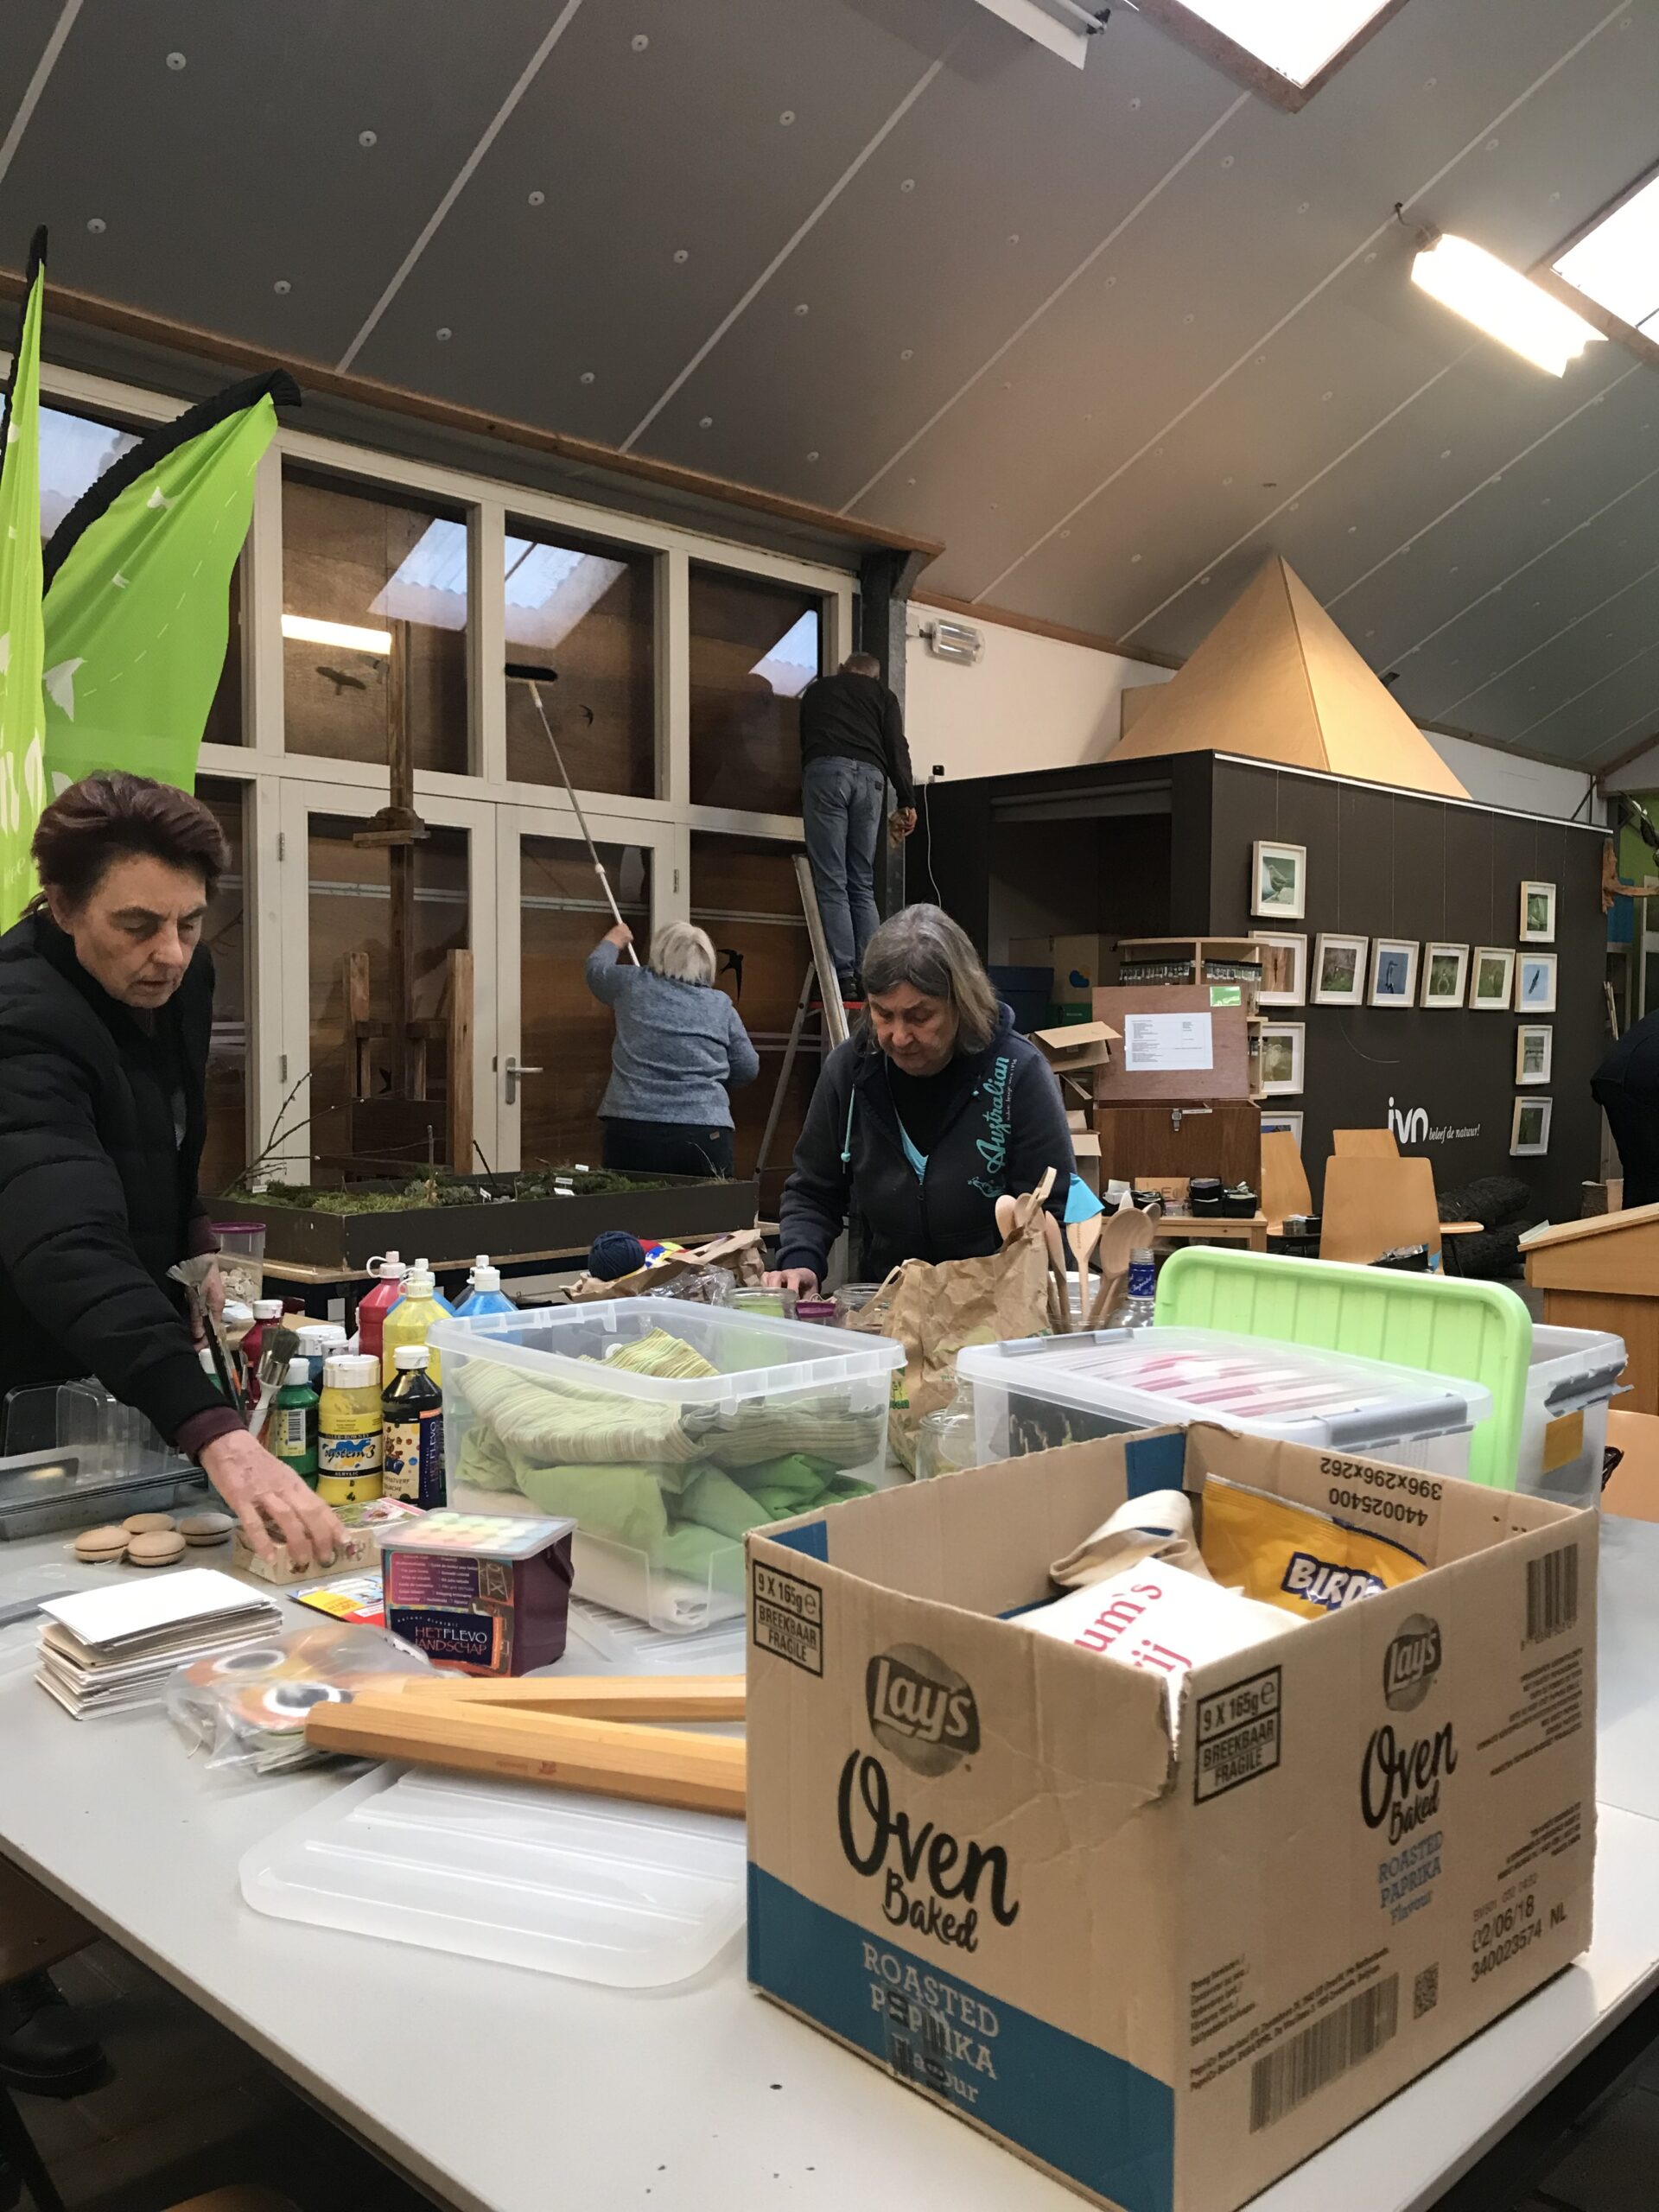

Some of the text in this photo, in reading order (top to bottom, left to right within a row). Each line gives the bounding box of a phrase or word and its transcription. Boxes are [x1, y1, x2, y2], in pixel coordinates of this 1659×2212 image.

[976, 1056, 1011, 1173] Australian
[1388, 1096, 1481, 1144] ivn beleef de natuur!
[1320, 1457, 1442, 1501] 396x296x262
[1329, 1488, 1428, 1527] 440025400
[758, 1573, 765, 1592] 9
[767, 1575, 776, 1597] X
[759, 1605, 817, 1647] BREEKBAAR
[768, 1629, 806, 1662] FRAGILE
[1204, 1710, 1212, 1732] 9
[1217, 1701, 1225, 1727] X
[1230, 1691, 1259, 1719] 165g
[1204, 1719, 1274, 1768] BREEKBAAR
[1215, 1747, 1263, 1786] FRAGILE
[1360, 1721, 1458, 1828] Oven
[838, 1749, 1019, 1926] Oven
[1389, 1779, 1440, 1846] Baked
[1378, 1830, 1443, 1884] ROASTED
[1381, 1857, 1441, 1909] PAPRIKA
[882, 1868, 977, 1953] Baked
[1472, 1894, 1535, 1953] 02/06/18
[1471, 1902, 1567, 1983] 340023574 NL
[862, 1942, 999, 2037] ROASTED
